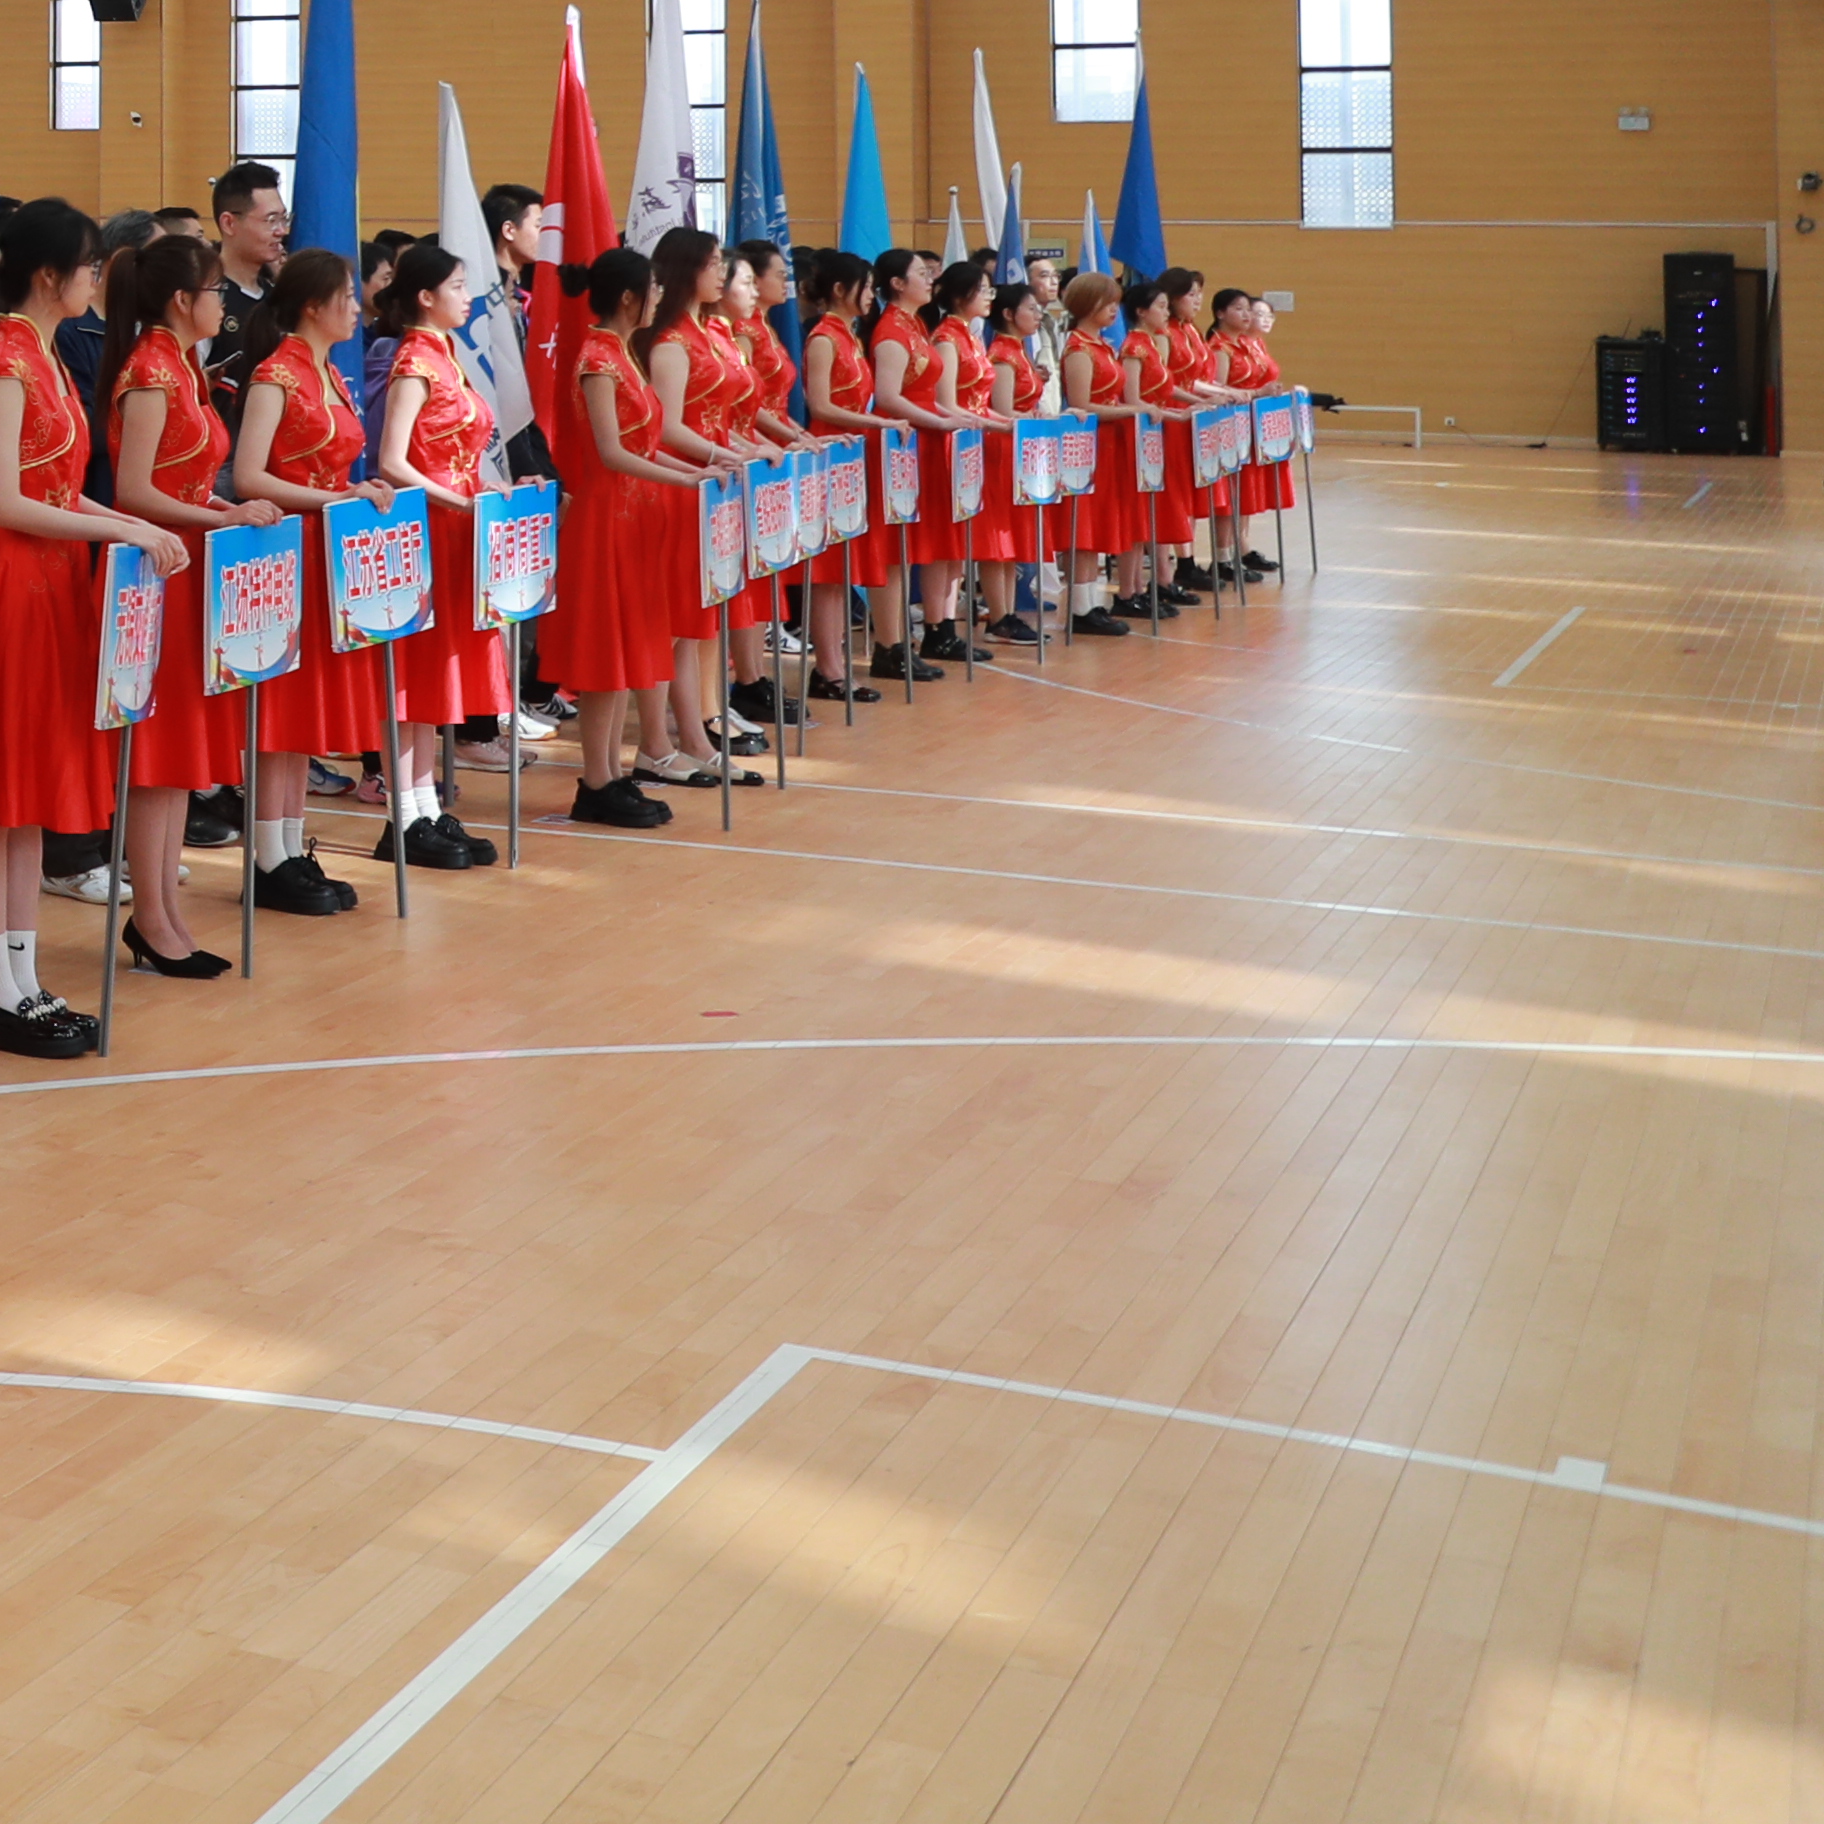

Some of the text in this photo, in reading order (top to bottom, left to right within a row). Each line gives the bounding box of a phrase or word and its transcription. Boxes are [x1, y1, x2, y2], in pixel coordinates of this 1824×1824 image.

[342, 520, 423, 601] 江苏省工信厅
